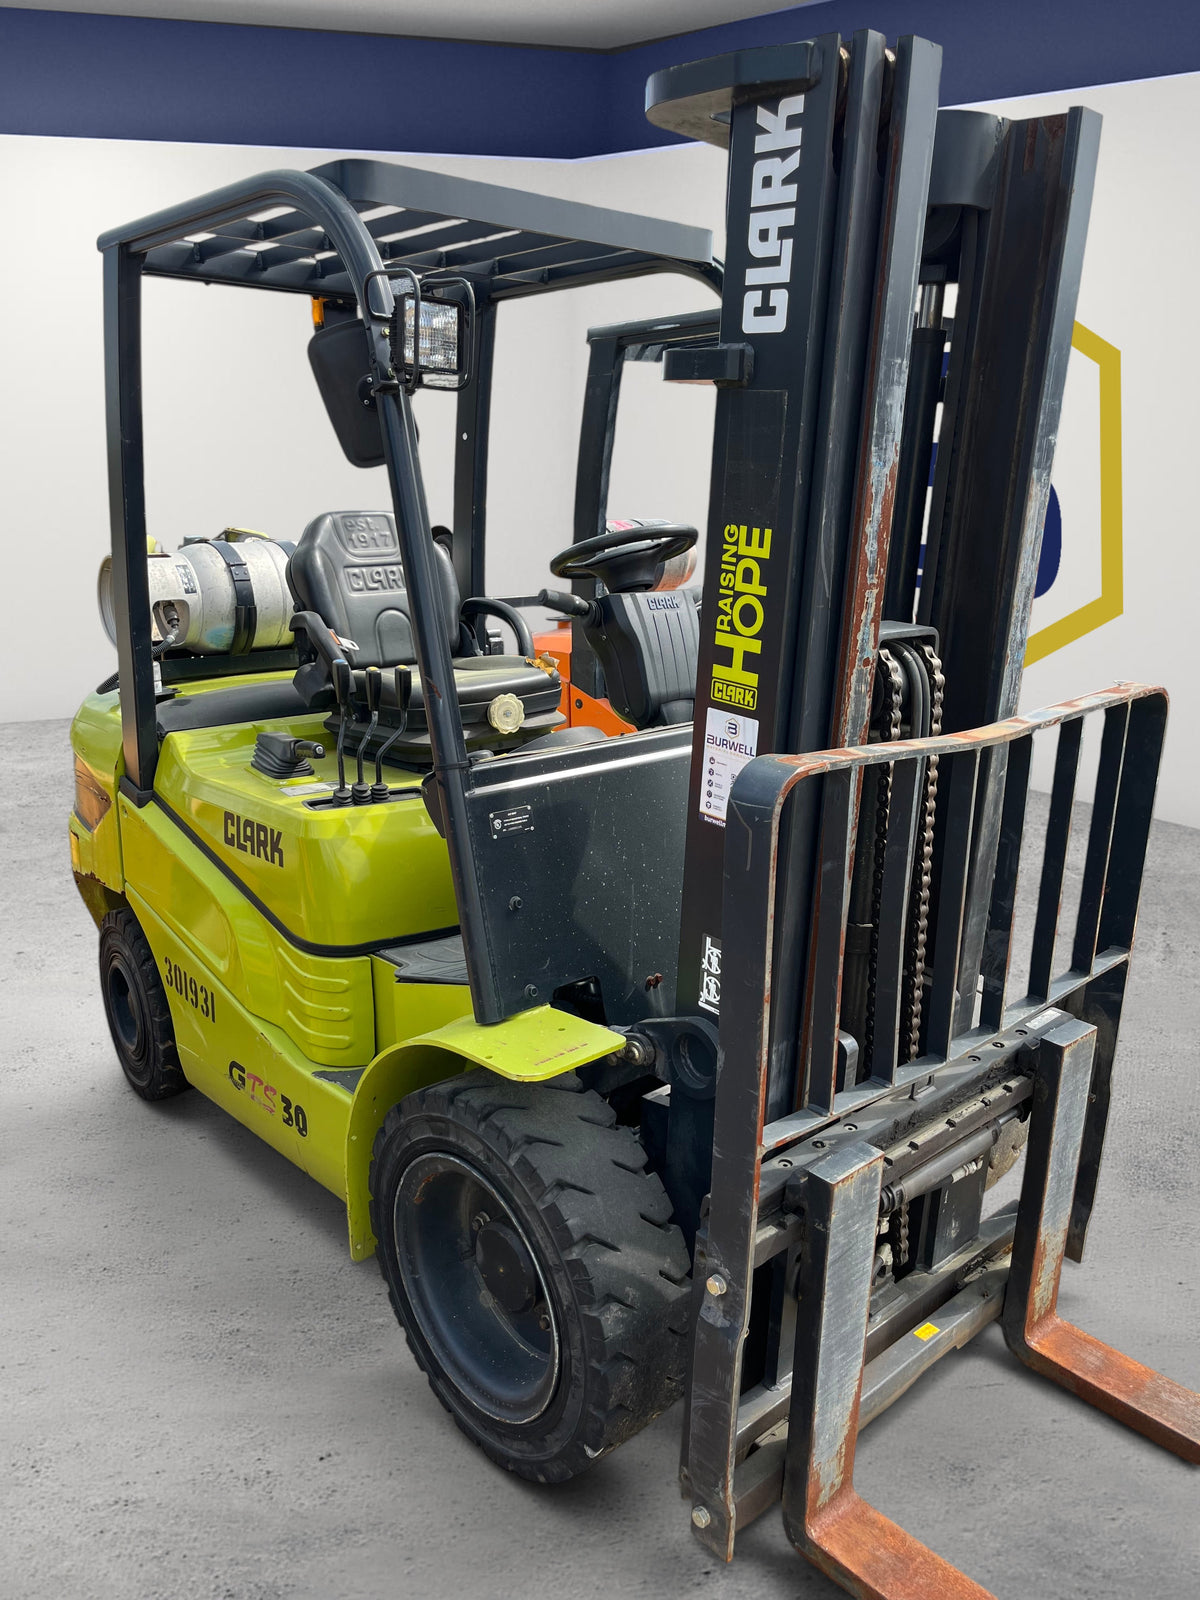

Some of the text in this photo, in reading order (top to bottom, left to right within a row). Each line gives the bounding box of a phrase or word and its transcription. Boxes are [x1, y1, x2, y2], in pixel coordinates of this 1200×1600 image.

[742, 94, 804, 334] CLARK
[348, 531, 391, 549] 1917
[347, 566, 407, 592] CLAR
[716, 524, 739, 632] RAISING
[646, 596, 680, 610] CLARK
[711, 525, 773, 688] HOPE
[713, 682, 755, 707] CLARK
[706, 733, 755, 757] BURWELL
[224, 810, 284, 868] CLARK
[164, 956, 216, 1024] 301931
